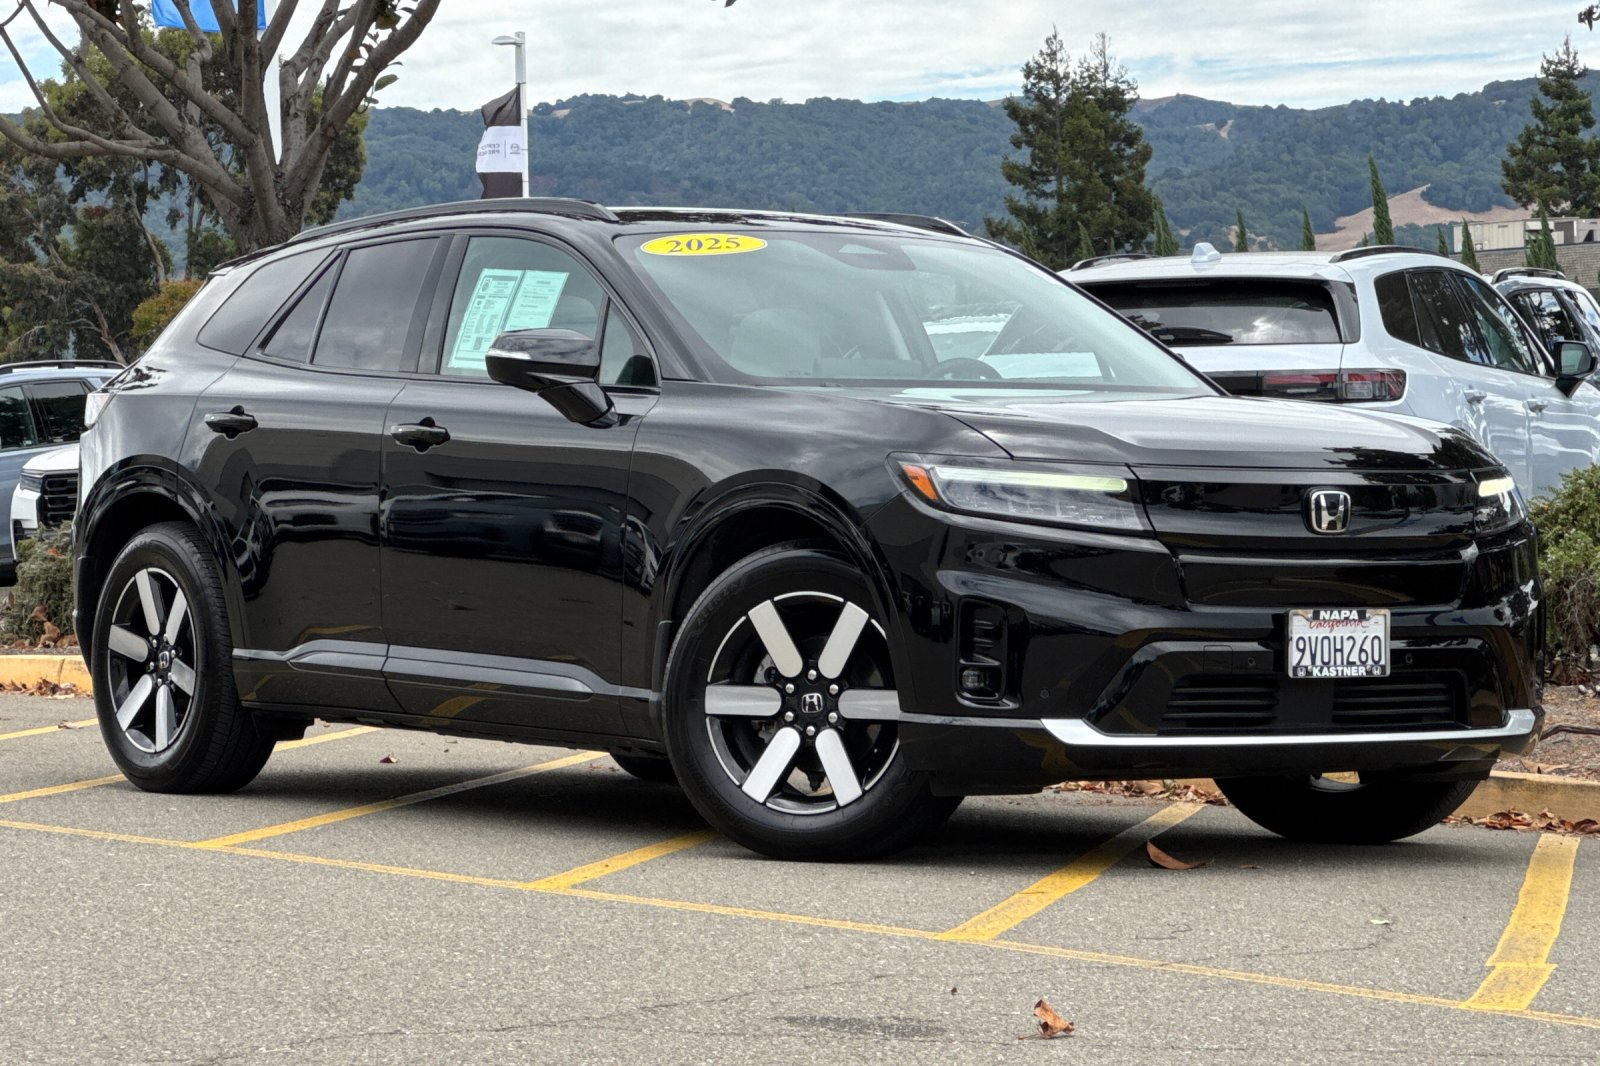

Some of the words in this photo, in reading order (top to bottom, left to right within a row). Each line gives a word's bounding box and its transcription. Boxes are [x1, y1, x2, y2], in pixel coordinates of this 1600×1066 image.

[665, 237, 741, 253] 2025
[1319, 610, 1359, 620] NAPA
[1312, 666, 1367, 677] KASTNER
